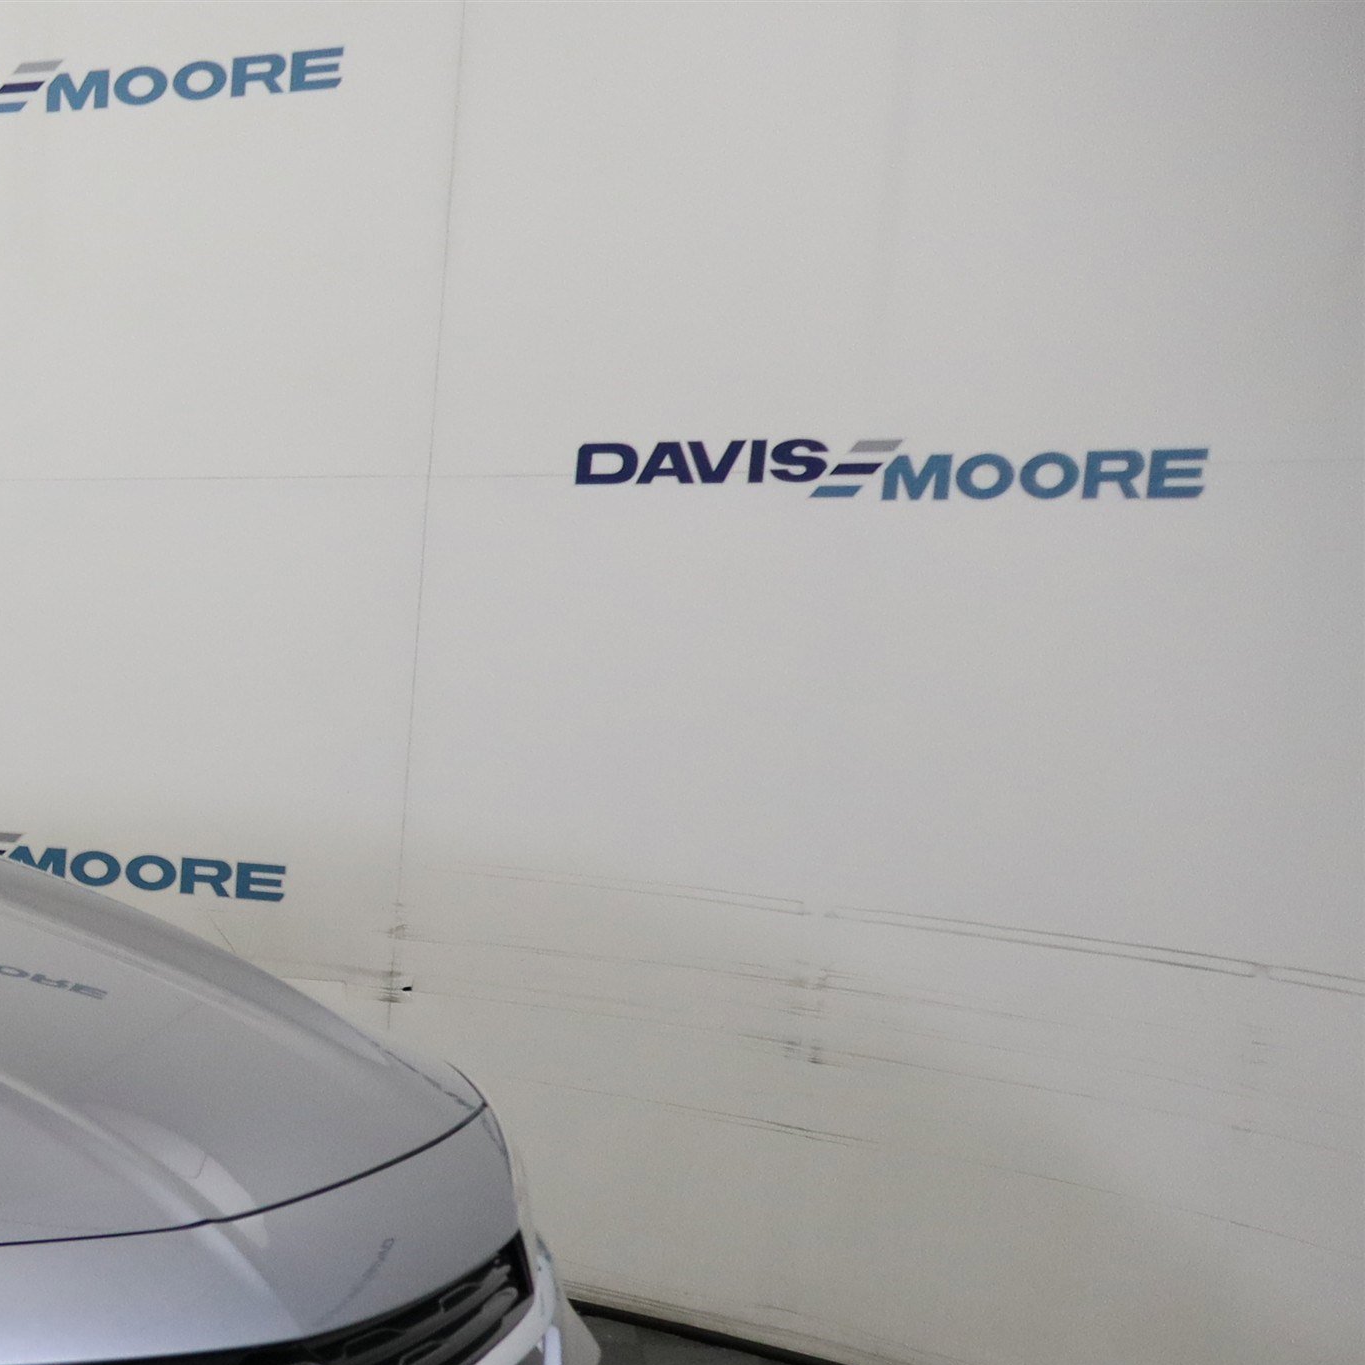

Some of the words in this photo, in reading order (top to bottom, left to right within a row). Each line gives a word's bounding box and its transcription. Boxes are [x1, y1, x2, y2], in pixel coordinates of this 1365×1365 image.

[45, 46, 345, 114] MOORE
[574, 438, 828, 485] DAVIS
[880, 447, 1209, 501] MOORE
[8, 845, 287, 902] MOORE
